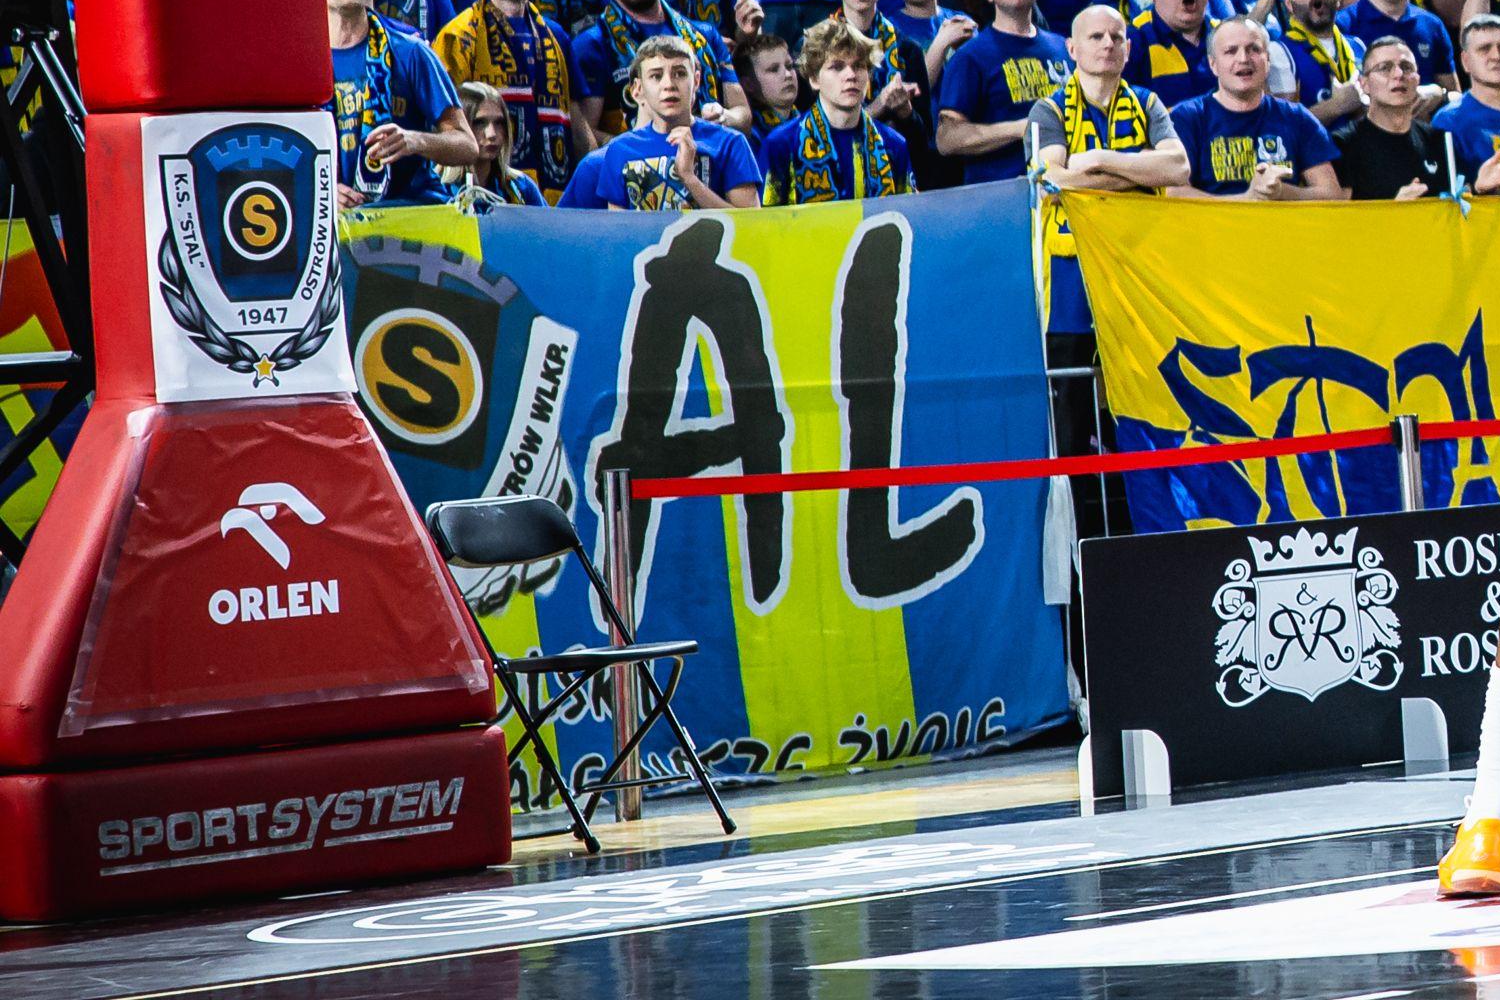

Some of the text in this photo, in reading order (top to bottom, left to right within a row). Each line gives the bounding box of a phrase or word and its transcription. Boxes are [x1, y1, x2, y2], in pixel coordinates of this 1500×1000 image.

[241, 193, 278, 248] S
[301, 164, 330, 301] OSTRÓW WLKP.
[237, 307, 289, 326] 1947
[529, 342, 569, 430] WLKP.
[208, 579, 340, 624] ORLEN
